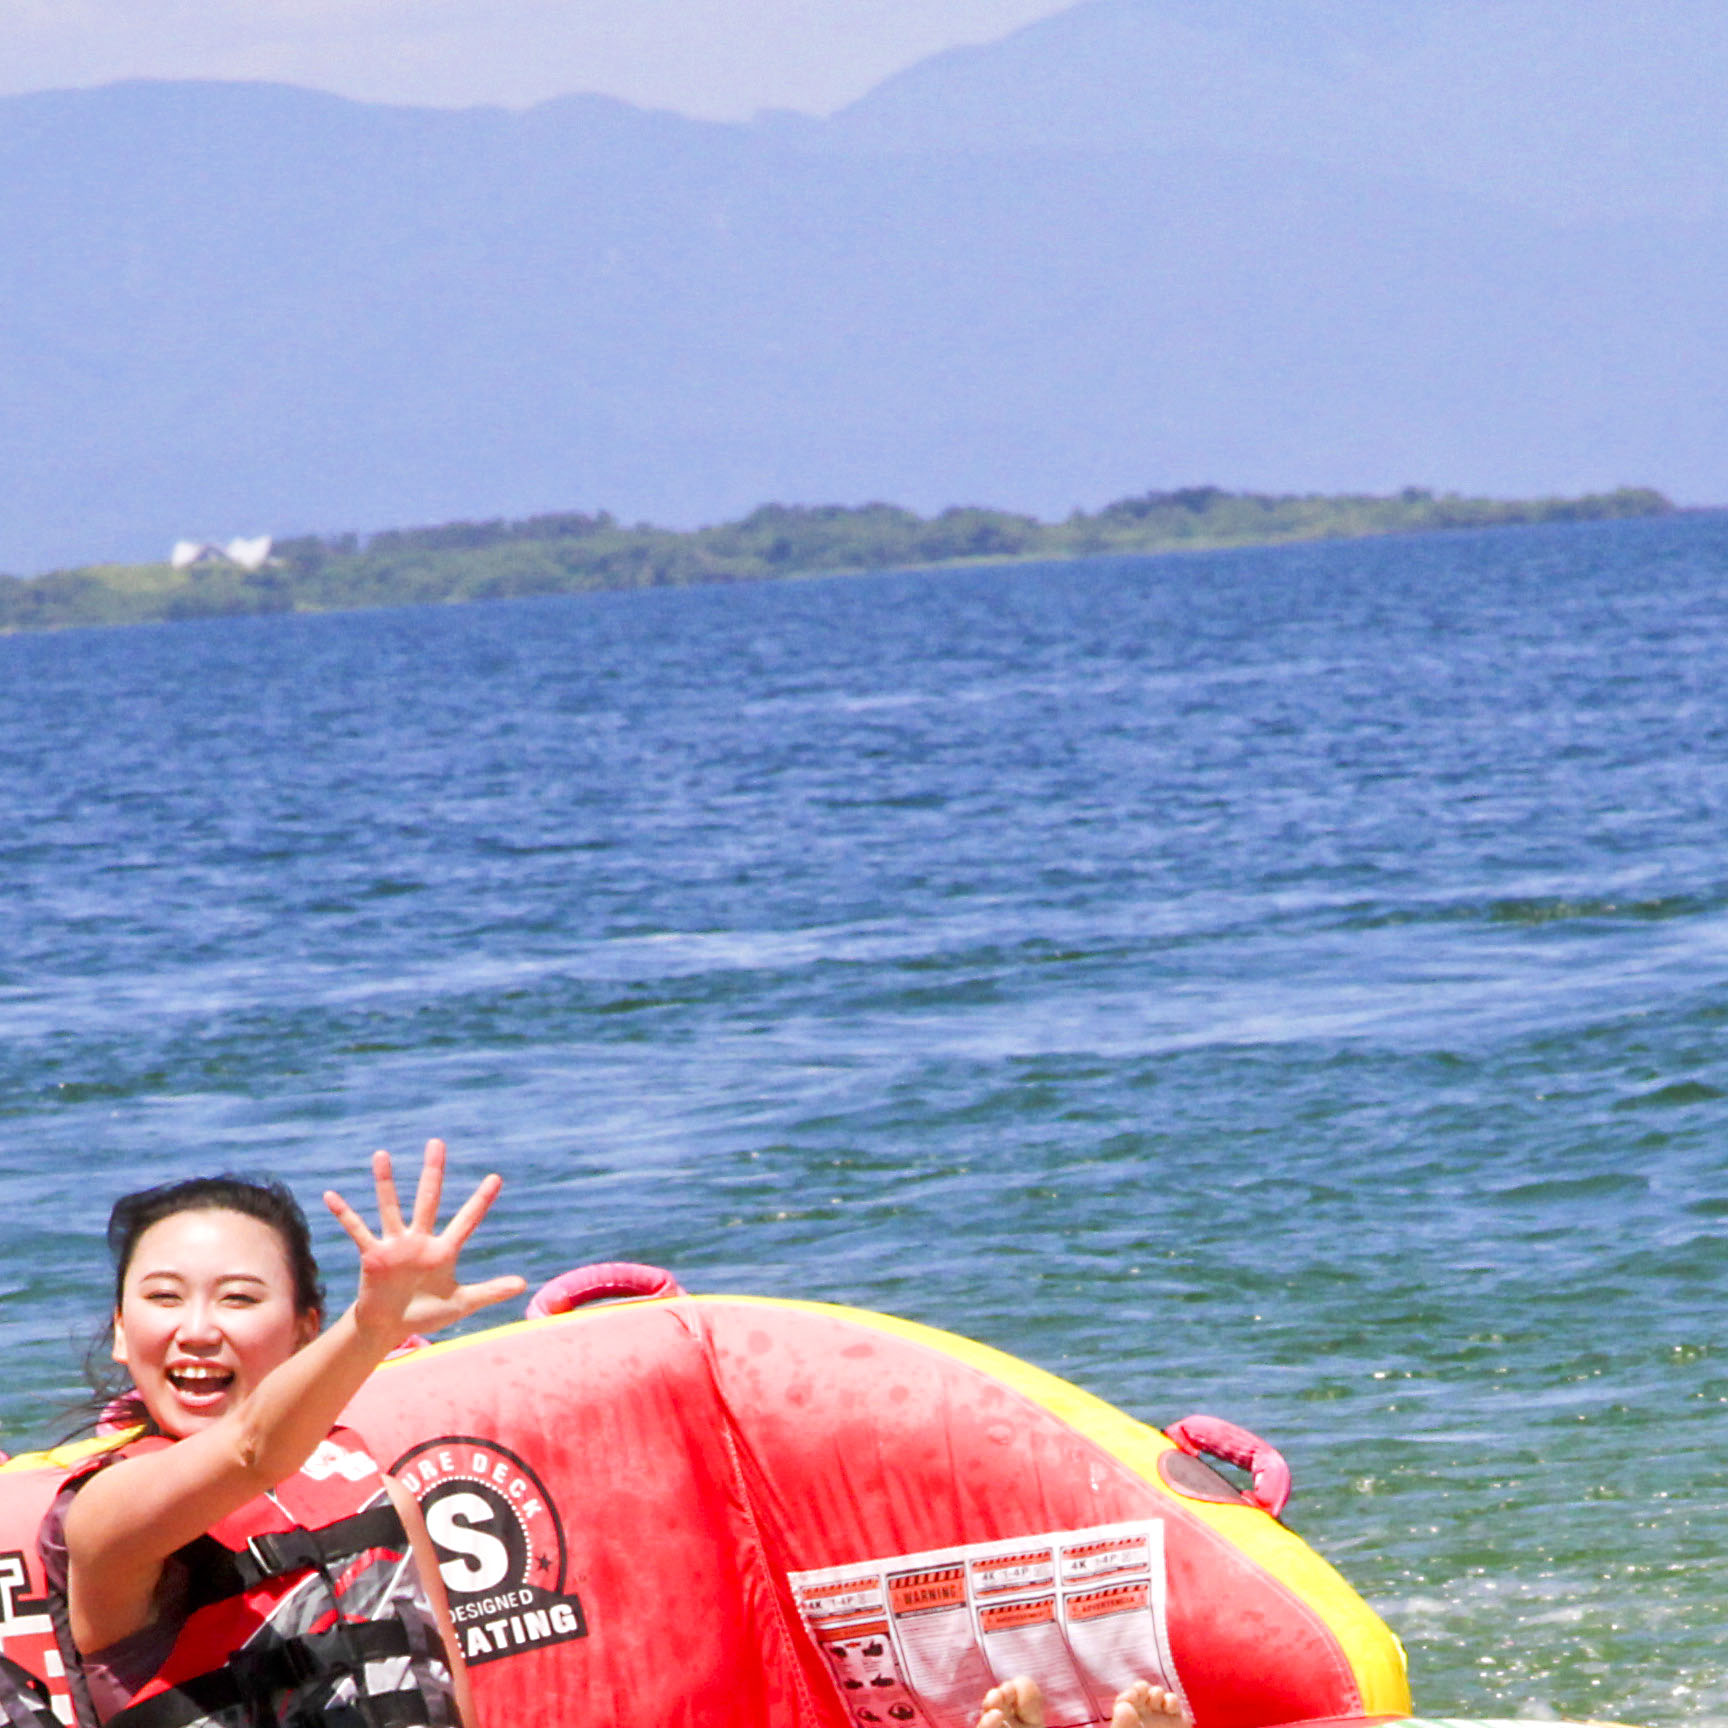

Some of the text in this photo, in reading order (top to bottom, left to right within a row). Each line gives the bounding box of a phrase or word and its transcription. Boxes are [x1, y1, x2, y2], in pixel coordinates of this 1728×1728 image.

[472, 1452, 543, 1519] DECK
[425, 1492, 509, 1593] S
[902, 1584, 958, 1606] WARNING
[454, 1603, 578, 1659] ATING
